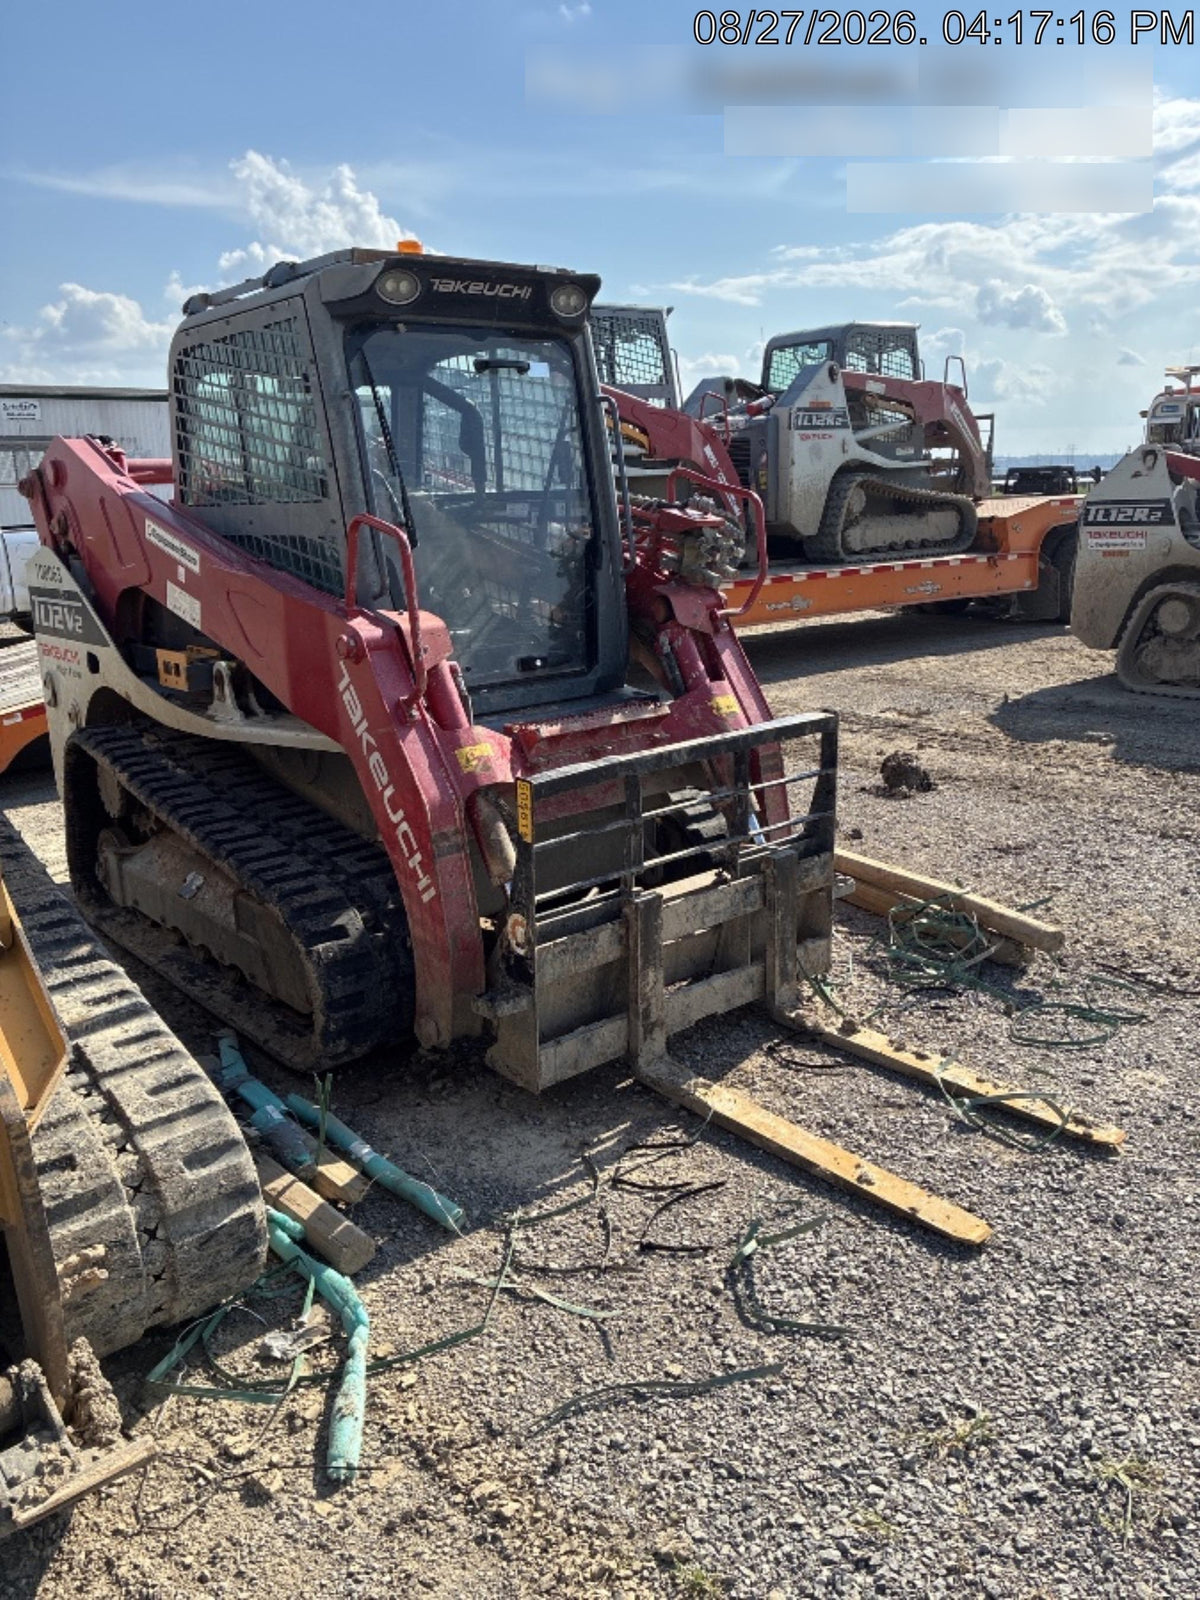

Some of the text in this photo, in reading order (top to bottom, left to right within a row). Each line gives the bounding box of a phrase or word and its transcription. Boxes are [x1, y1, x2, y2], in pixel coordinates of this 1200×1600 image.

[430, 278, 532, 300] TAKEUCHI
[1086, 531, 1148, 540] TAKEUCHI
[337, 660, 437, 903] TAKEUCHI
